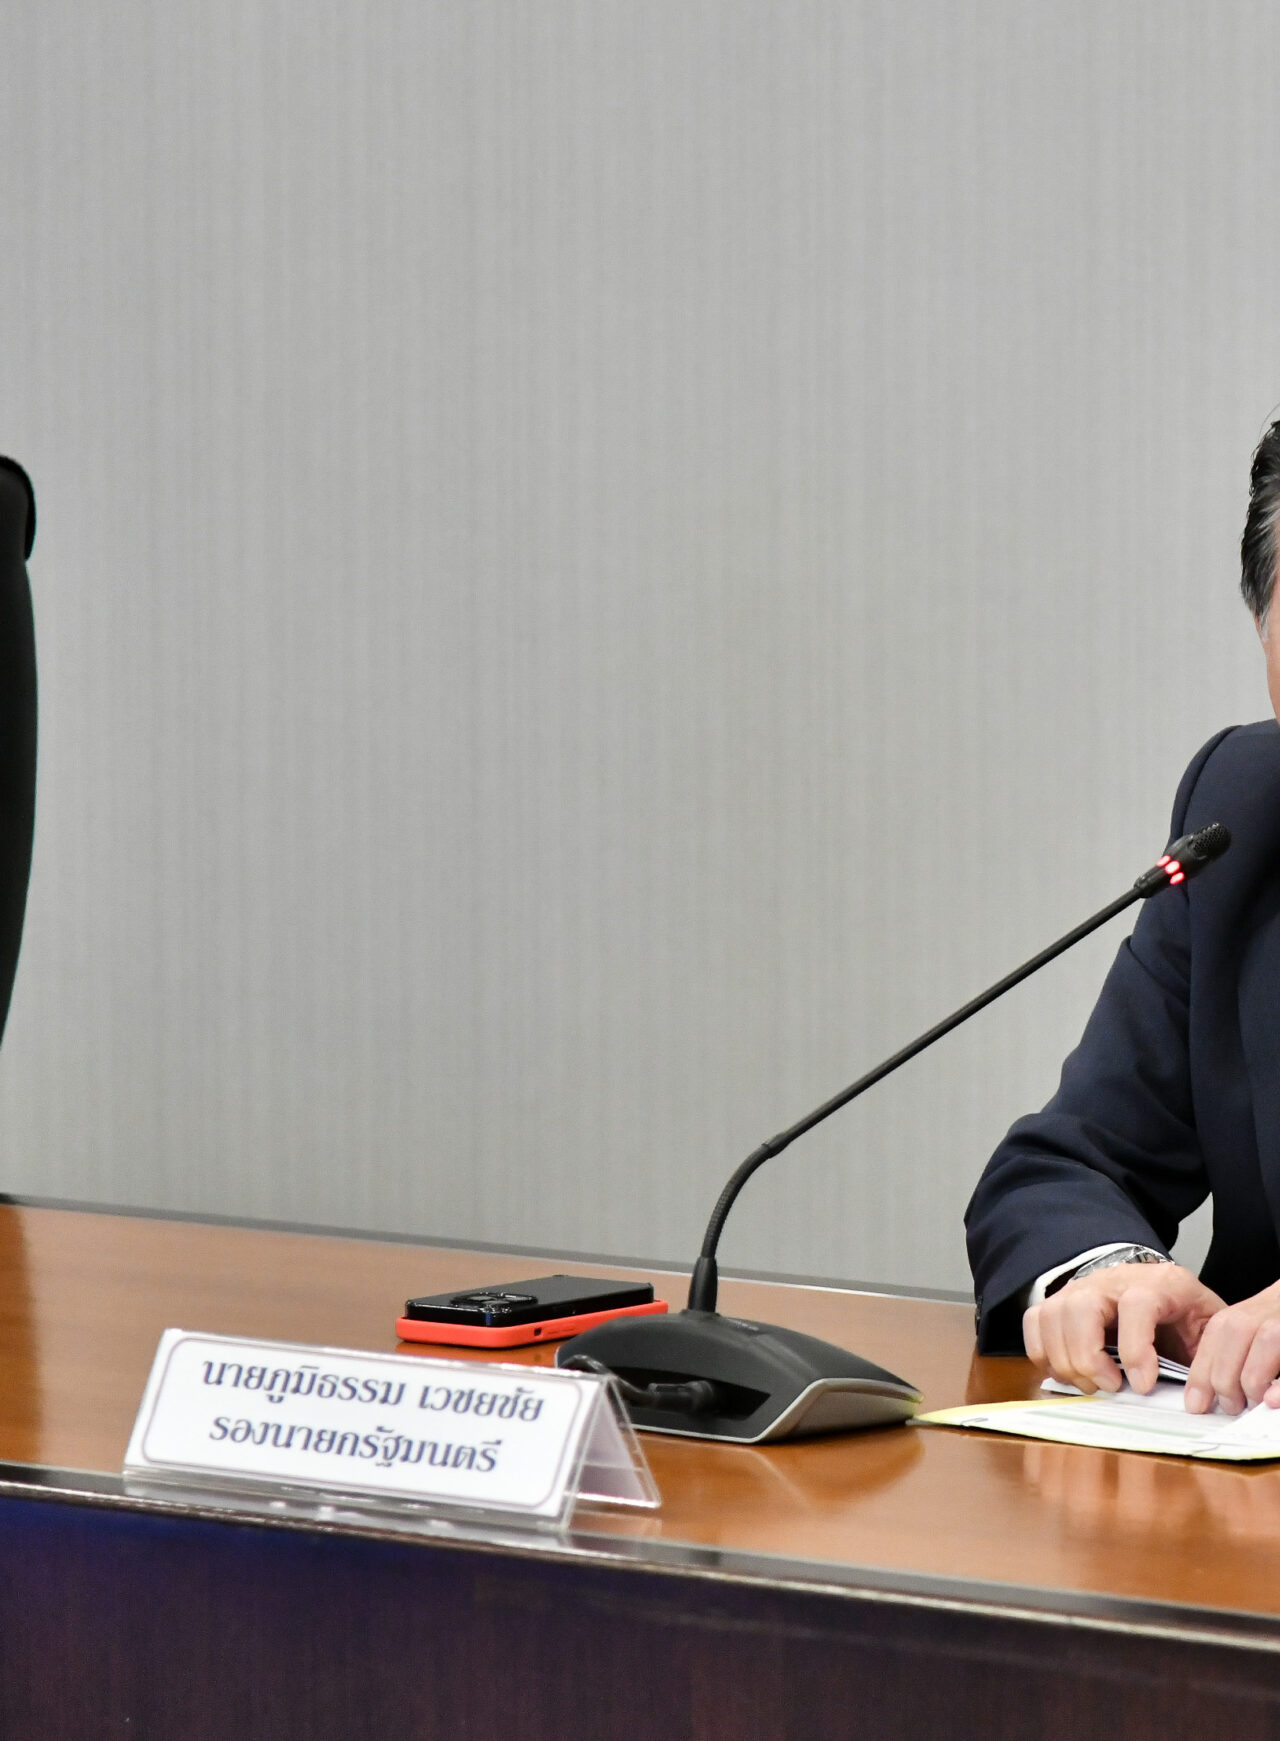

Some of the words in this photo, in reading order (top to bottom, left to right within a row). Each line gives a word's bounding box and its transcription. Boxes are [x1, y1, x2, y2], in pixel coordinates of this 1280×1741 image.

[202, 1358, 406, 1404] นายภูมิธรรม
[418, 1384, 544, 1422] เวชยชัย
[209, 1415, 502, 1472] รองนายกรัฐมนตรี
